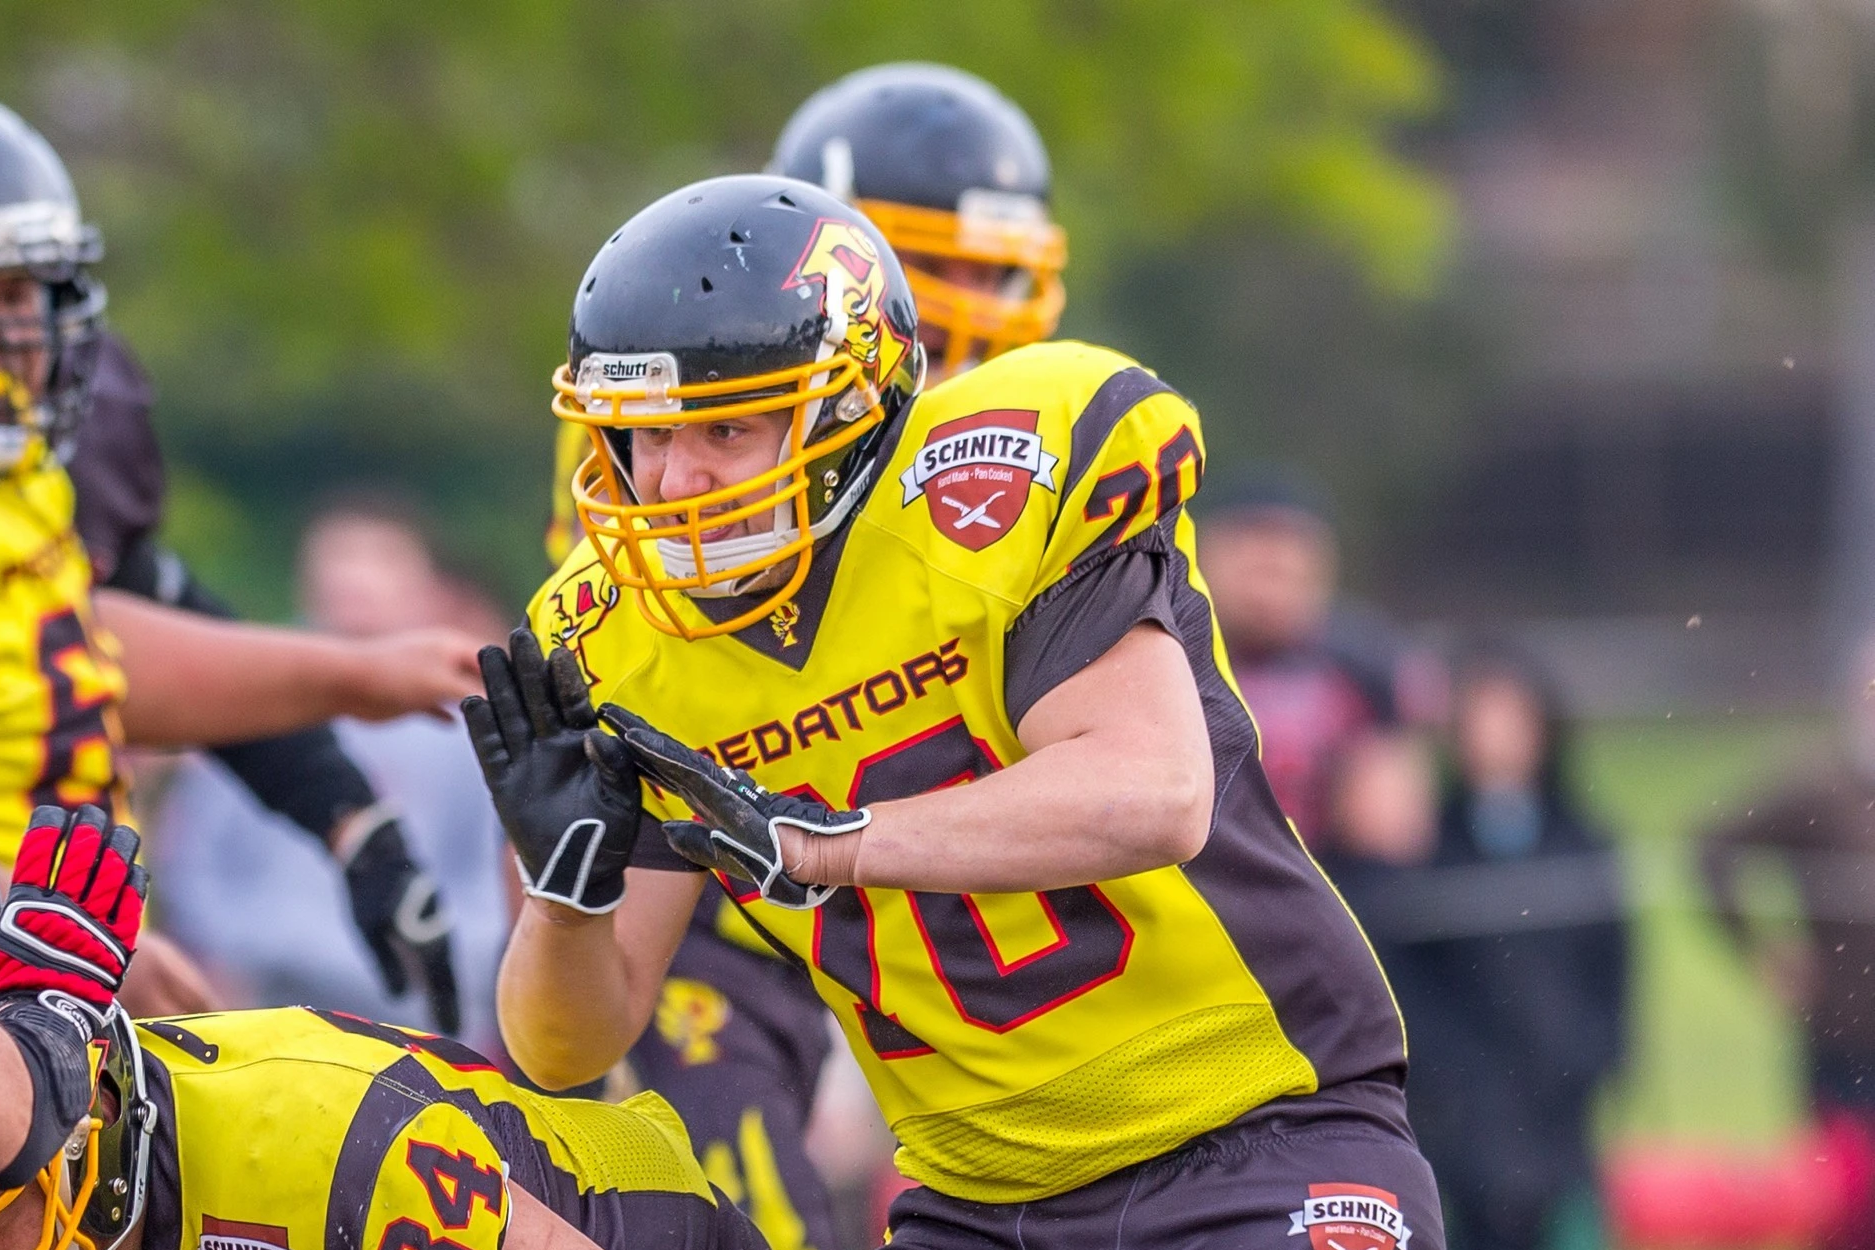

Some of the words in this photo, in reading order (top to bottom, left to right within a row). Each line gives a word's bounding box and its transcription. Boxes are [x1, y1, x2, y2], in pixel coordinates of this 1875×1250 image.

[603, 361, 648, 377] schutt
[923, 434, 1030, 472] SCHNITZ
[974, 468, 988, 480] Pan
[1313, 1202, 1398, 1230] SCHNITZ
